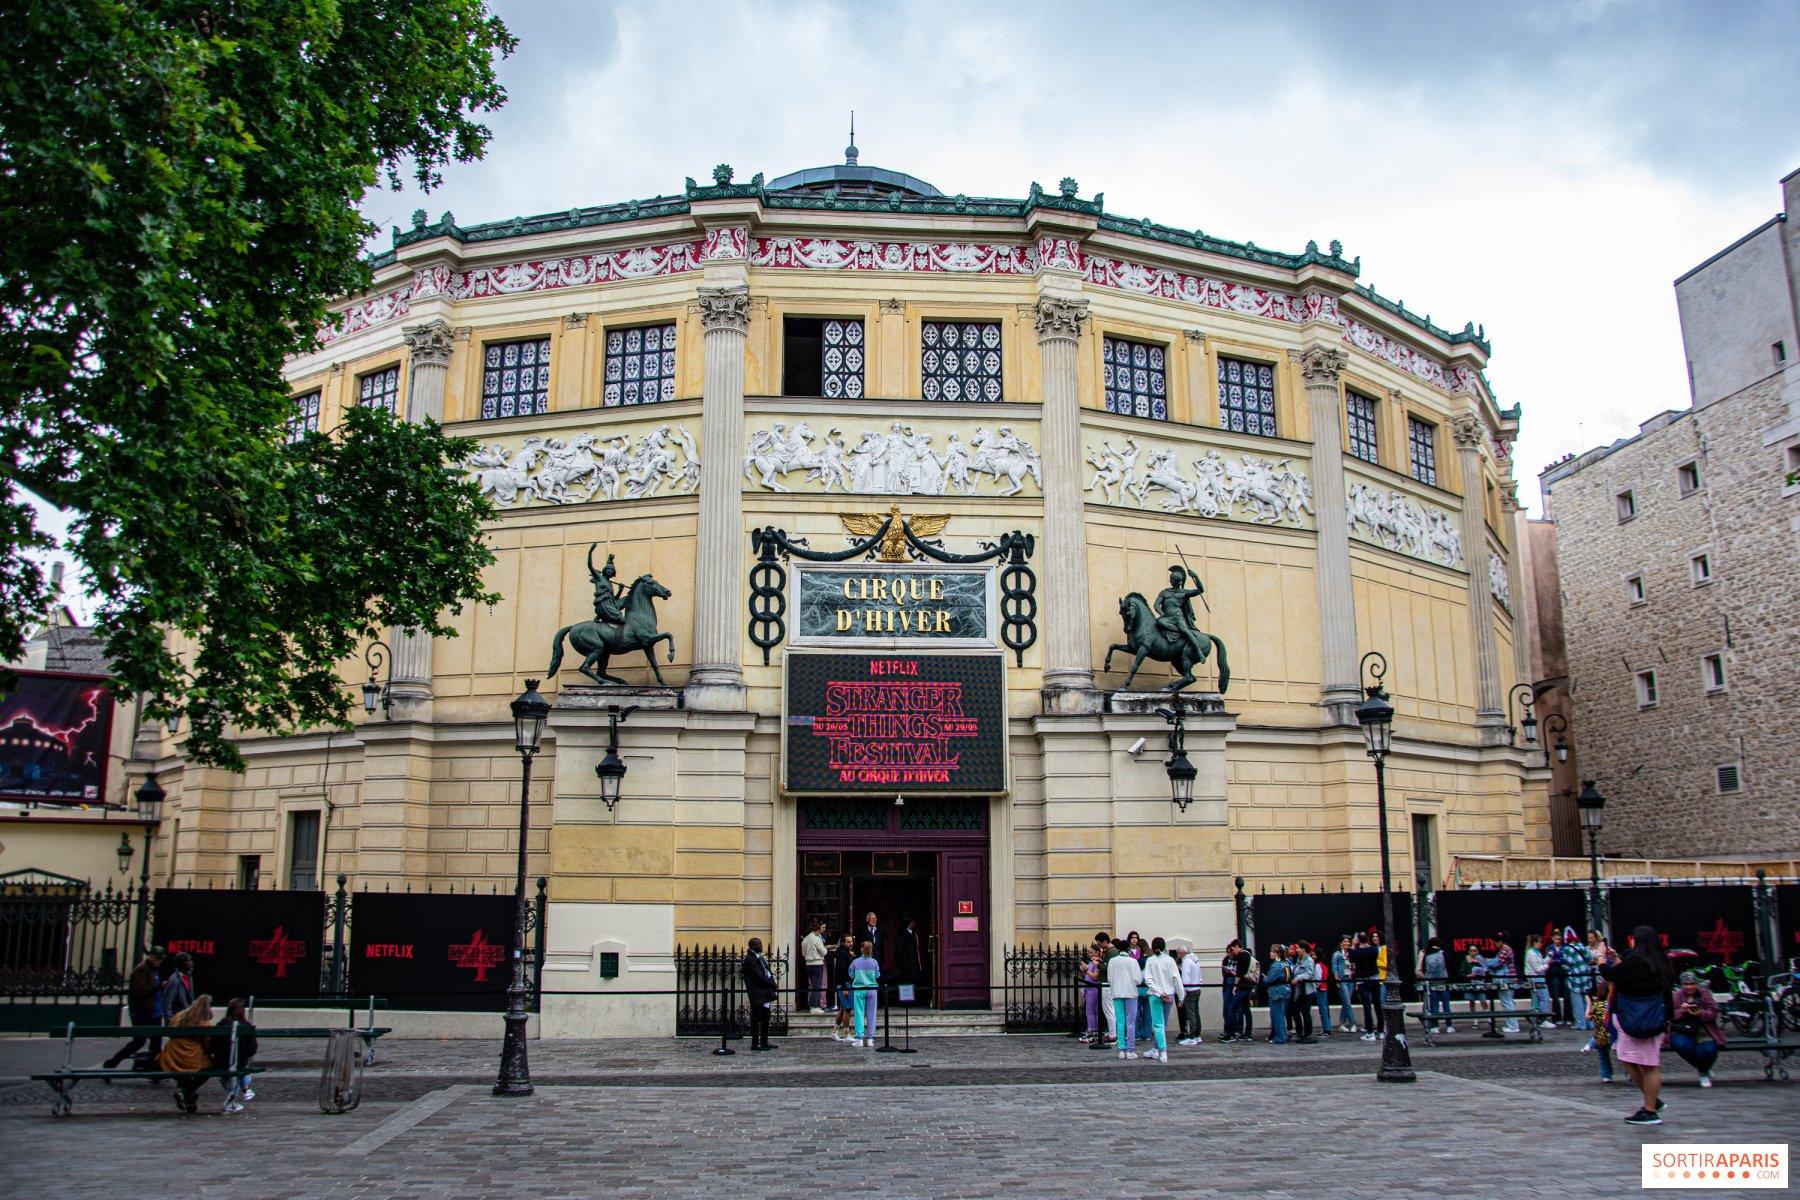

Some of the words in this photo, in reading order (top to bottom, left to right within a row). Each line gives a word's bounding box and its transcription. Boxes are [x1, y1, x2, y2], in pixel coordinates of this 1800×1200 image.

[843, 578, 944, 605] CIRQUE
[836, 609, 951, 632] D'HIVER
[870, 660, 918, 676] NETFLIX
[826, 685, 964, 717] STRANGER
[813, 723, 824, 731] DU
[849, 713, 943, 738] THINGS
[829, 736, 959, 765] FESTIVAL
[839, 770, 855, 782] AU
[857, 770, 901, 784] CIRQUE
[903, 770, 949, 782] D'HIVER
[168, 940, 215, 955] NETFLIX
[366, 944, 414, 959] NETFLIX
